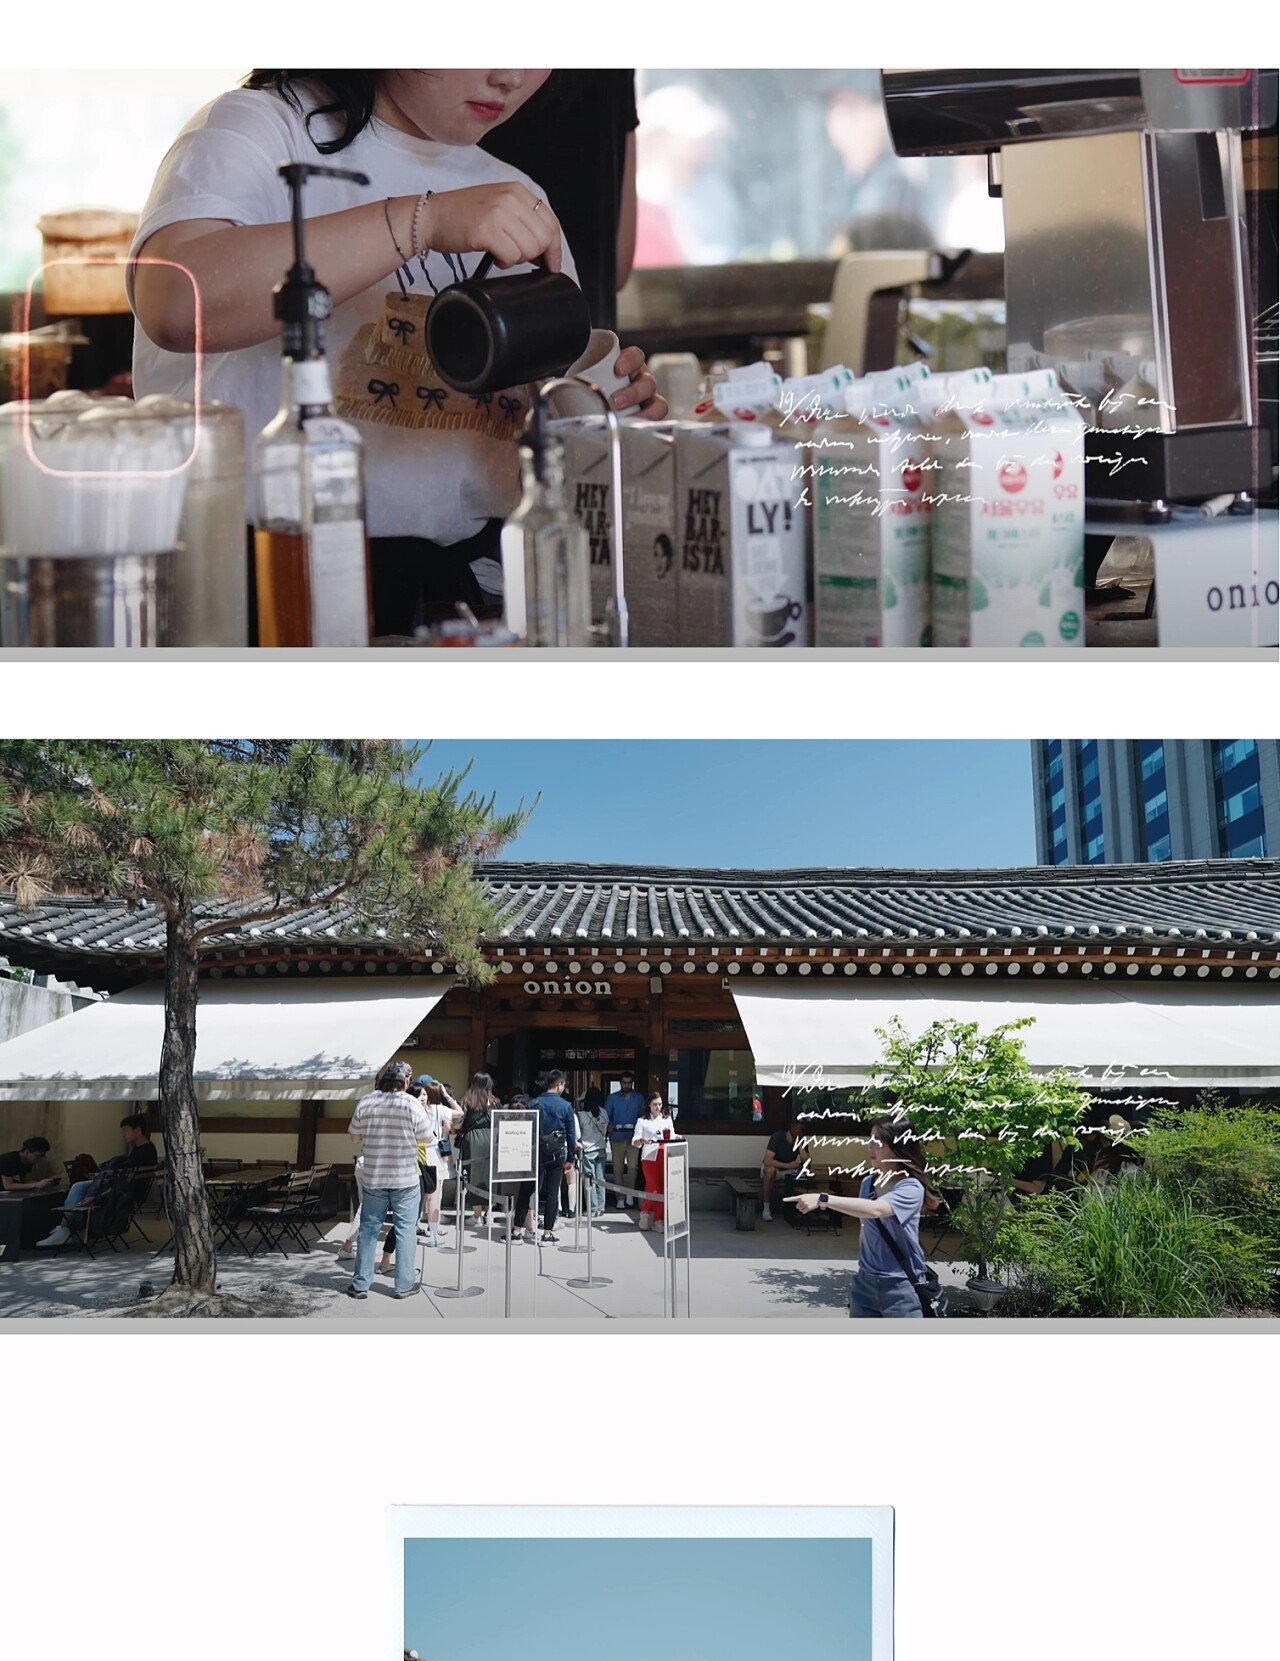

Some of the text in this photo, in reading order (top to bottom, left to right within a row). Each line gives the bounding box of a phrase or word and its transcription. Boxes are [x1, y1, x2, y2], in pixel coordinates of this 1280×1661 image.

[577, 483, 609, 508] HEY
[688, 488, 722, 515] HEY
[746, 501, 793, 536] LY!
[683, 545, 724, 575] ISTA
[1207, 570, 1279, 611] onio
[523, 975, 612, 995] onion
